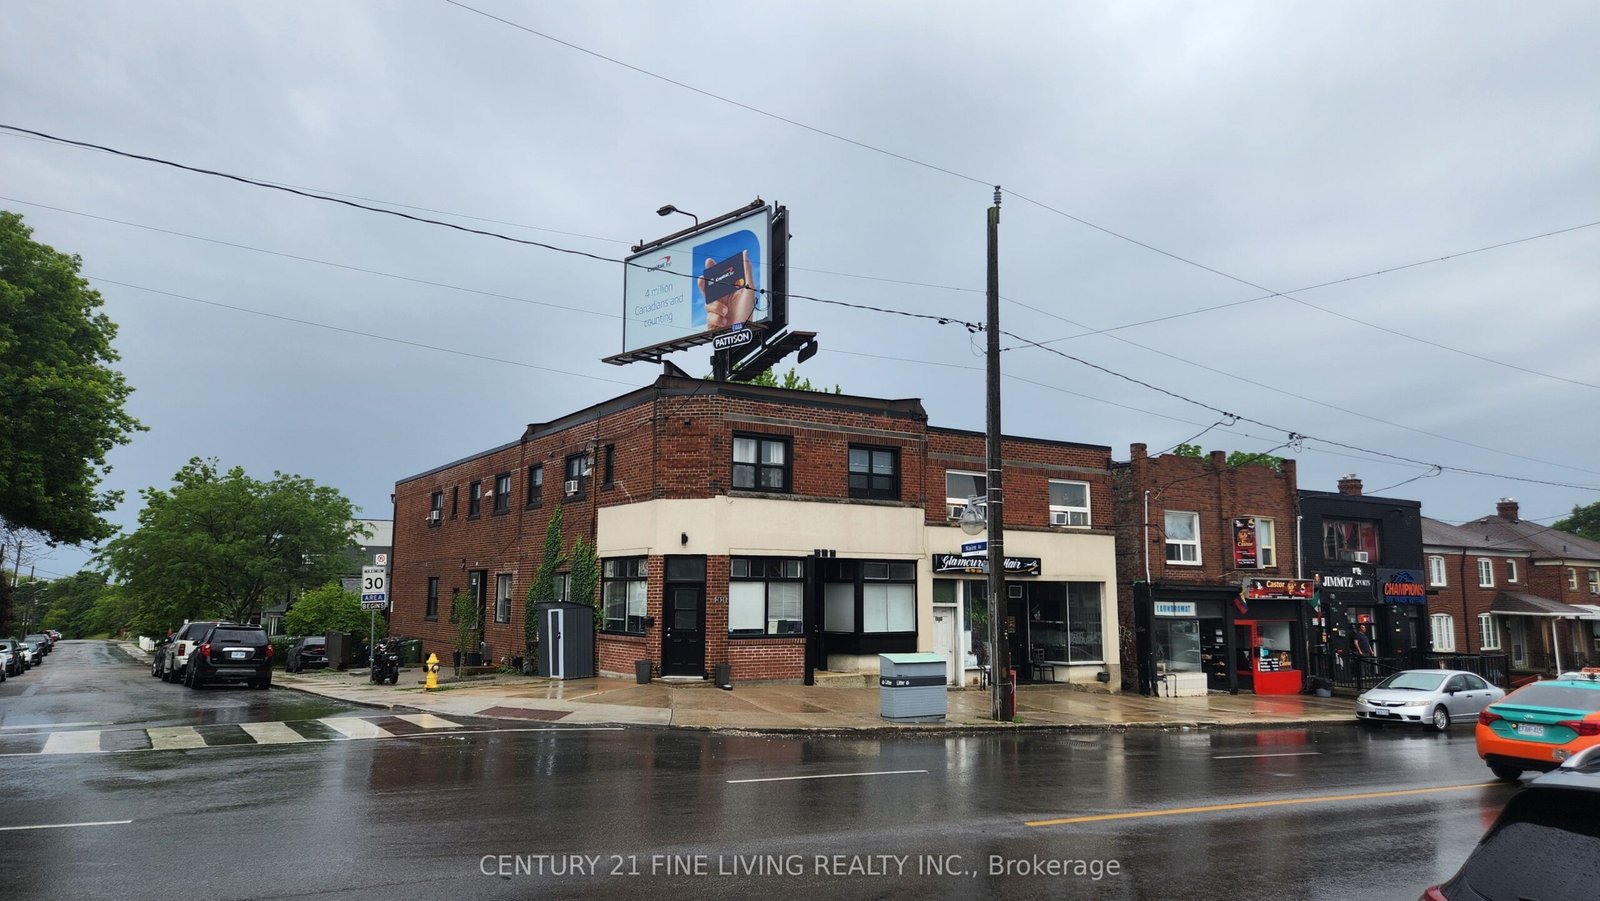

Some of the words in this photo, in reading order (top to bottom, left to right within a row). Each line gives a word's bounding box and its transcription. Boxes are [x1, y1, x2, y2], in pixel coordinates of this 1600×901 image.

[644, 289, 650, 298] 4
[651, 283, 673, 296] million
[634, 299, 669, 316] Canadians
[670, 292, 684, 306] and
[644, 312, 673, 327] counting
[715, 332, 750, 347] PATTISON
[1003, 558, 1021, 569] Hair
[364, 577, 384, 589] 30
[1266, 580, 1286, 588] Castor
[1322, 576, 1354, 588] JIMMYZ
[1354, 579, 1371, 587] SPORTS
[1384, 583, 1425, 596] CHAMPIONS
[362, 602, 384, 610] BEGINS
